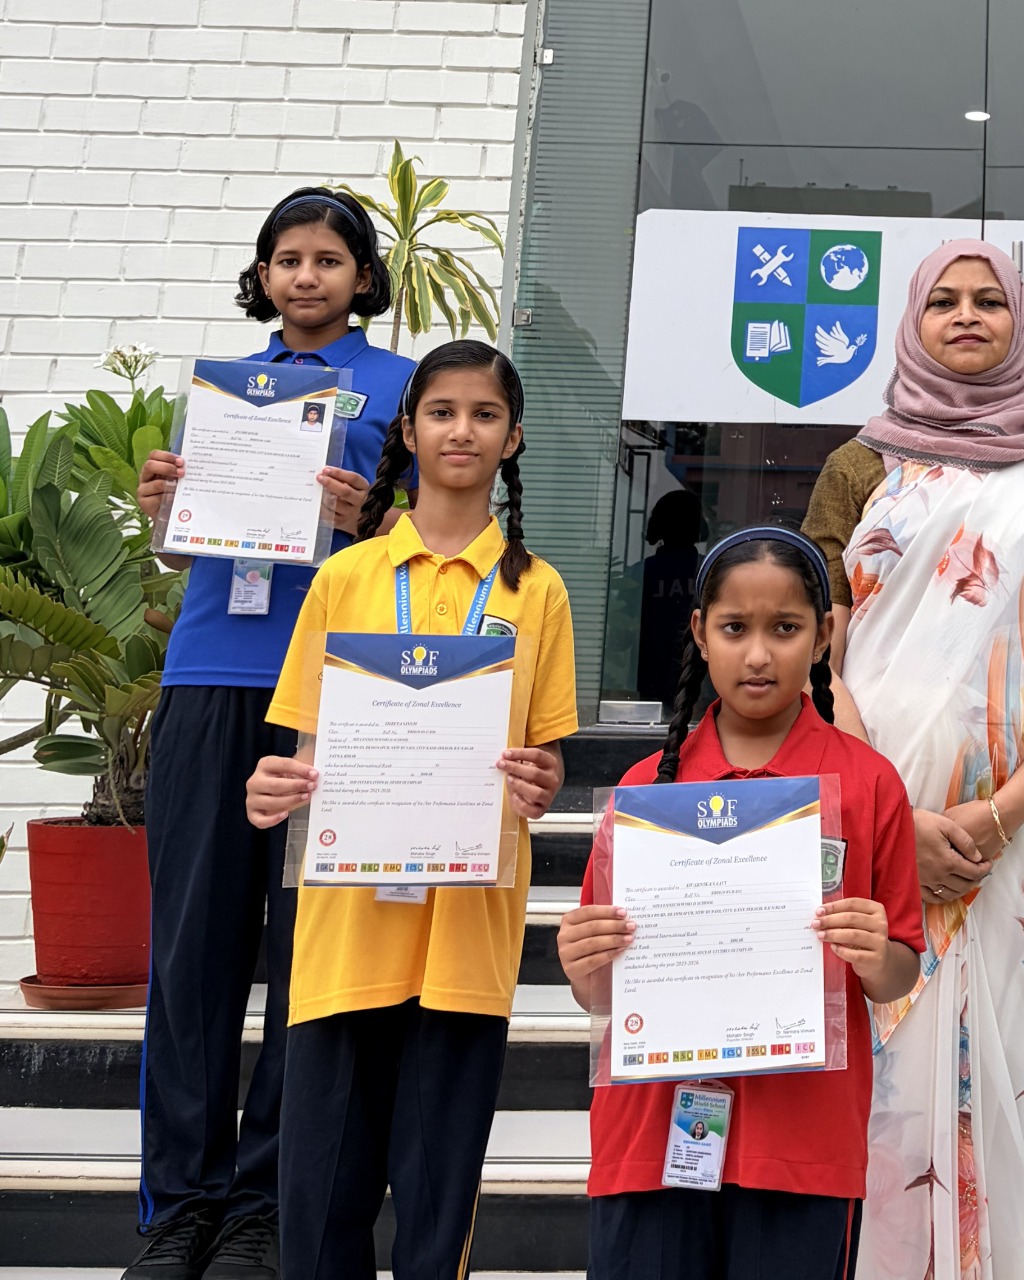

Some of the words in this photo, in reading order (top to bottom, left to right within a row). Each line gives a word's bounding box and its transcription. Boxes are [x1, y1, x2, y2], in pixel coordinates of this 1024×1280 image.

[399, 582, 409, 635] llennium
[465, 584, 489, 635] illennium
[400, 665, 438, 675] OLYMPIADS
[371, 699, 403, 708] Certificate
[697, 816, 737, 828] OLYMPIADS
[669, 857, 704, 868] Certificate
[705, 857, 712, 865] of
[713, 856, 732, 864] Zonal
[733, 854, 767, 863] Excellence
[629, 1018, 638, 1027] 28
